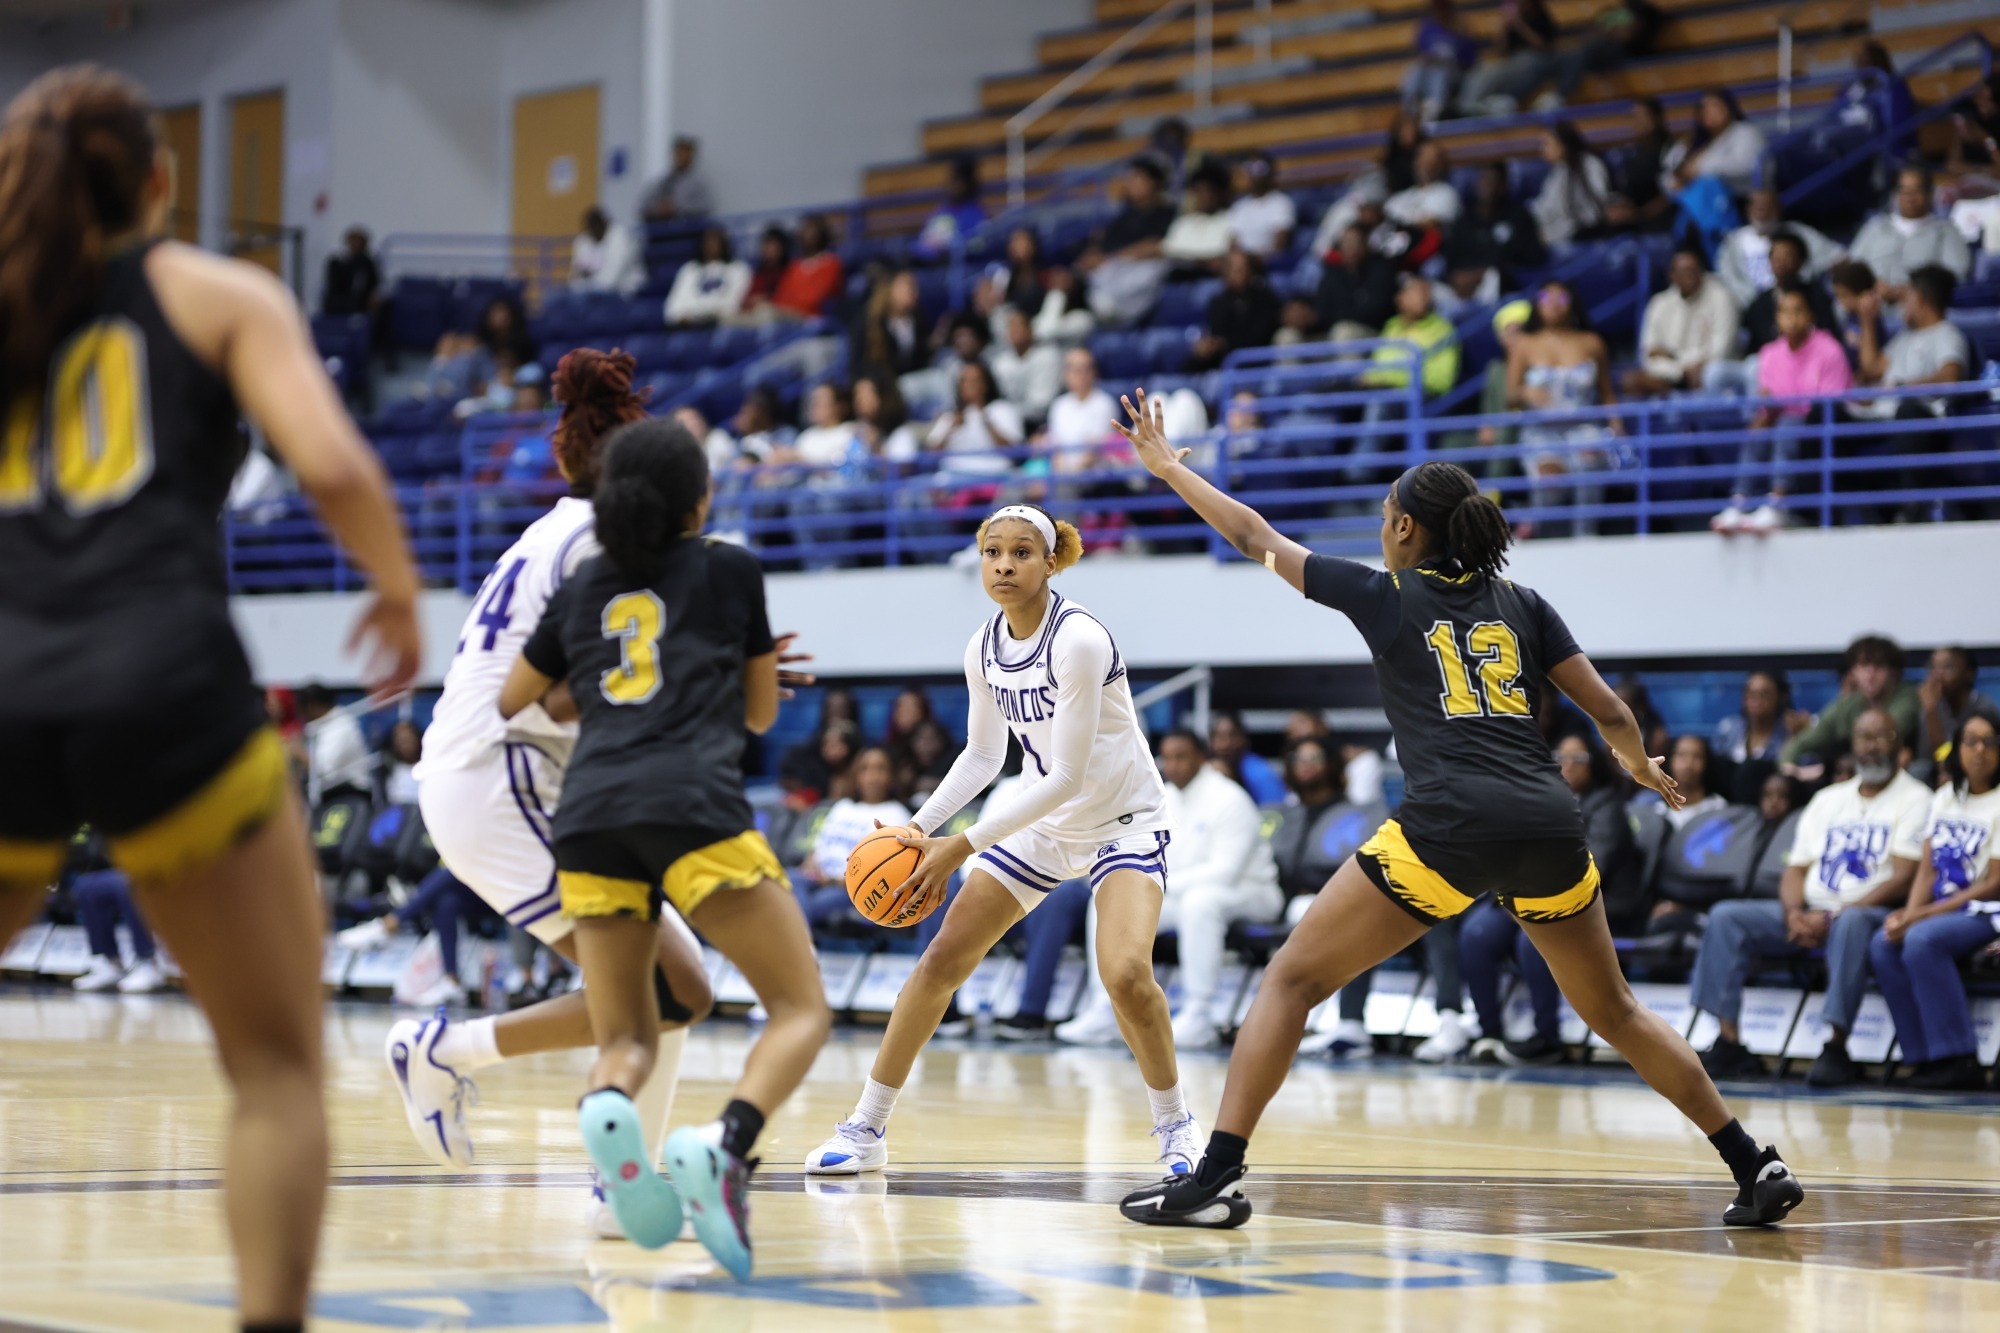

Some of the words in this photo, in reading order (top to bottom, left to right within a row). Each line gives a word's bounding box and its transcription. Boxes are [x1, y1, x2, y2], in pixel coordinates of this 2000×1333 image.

[457, 557, 528, 654] 4
[600, 588, 667, 706] 3
[988, 683, 1056, 722] RONCOS
[1424, 620, 1533, 719] 12
[863, 877, 890, 912] EVO
